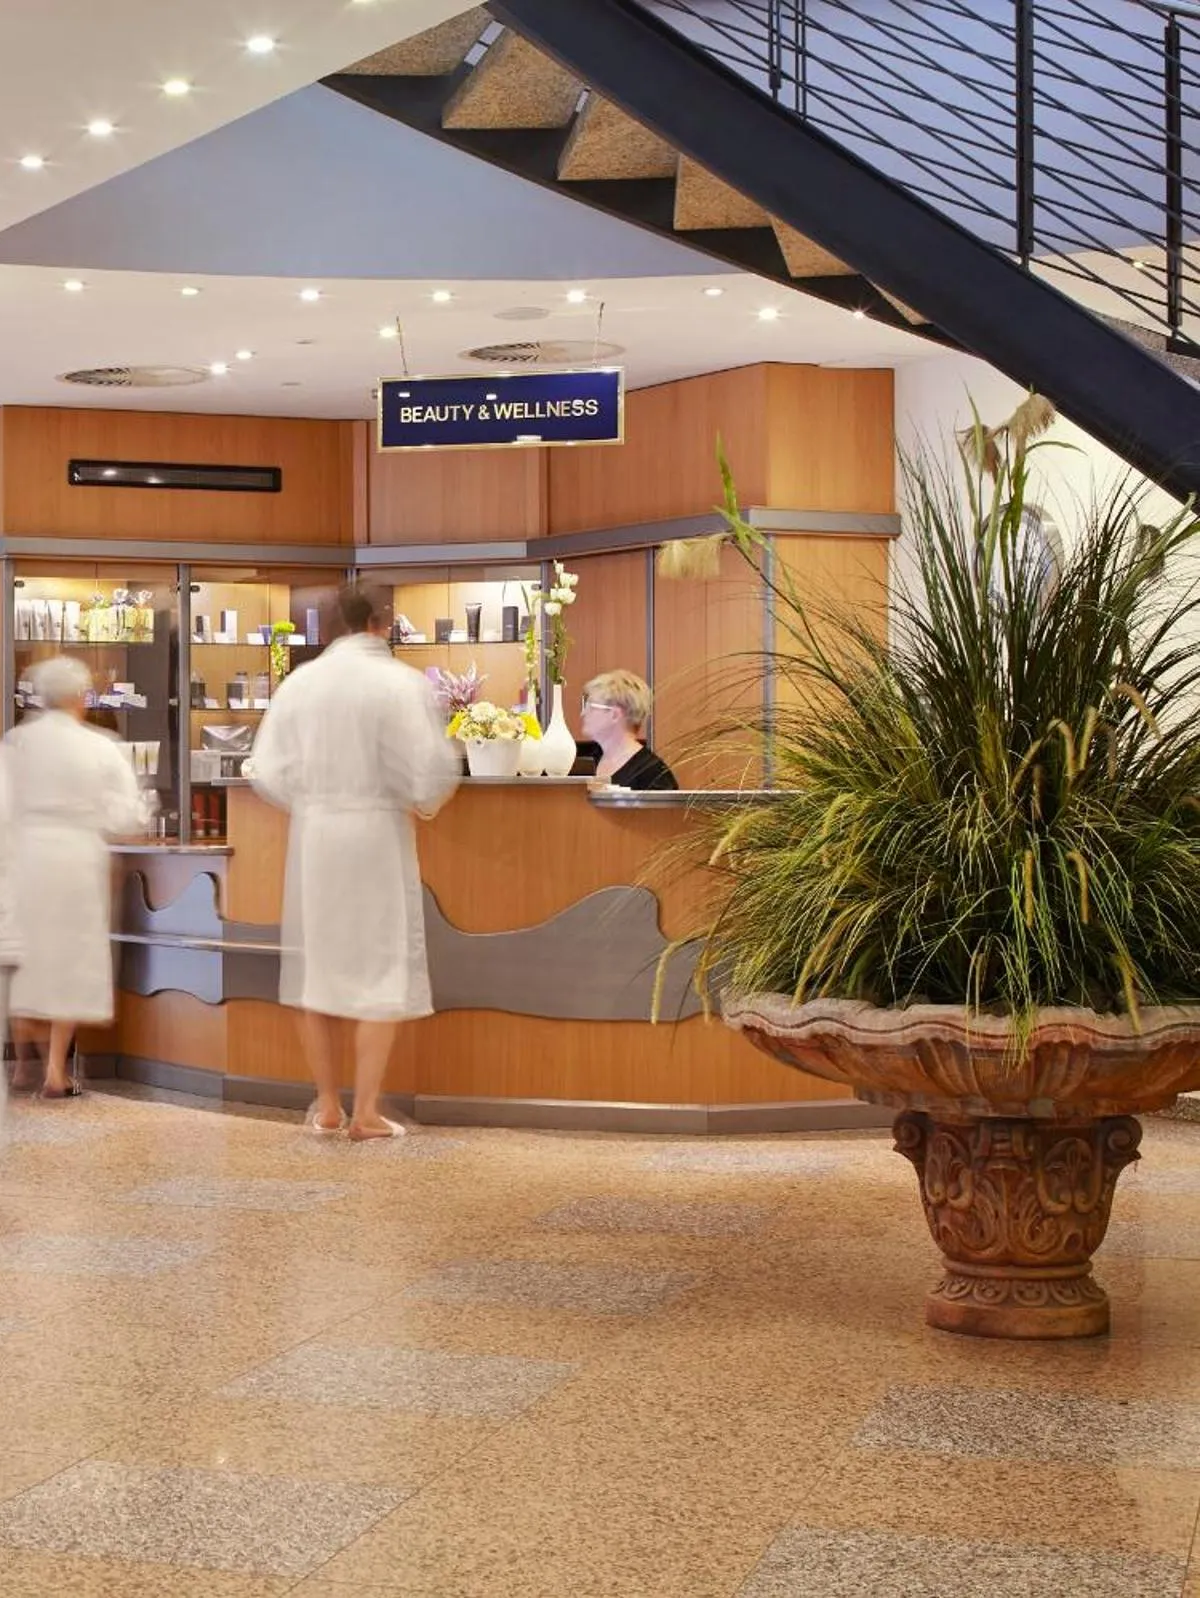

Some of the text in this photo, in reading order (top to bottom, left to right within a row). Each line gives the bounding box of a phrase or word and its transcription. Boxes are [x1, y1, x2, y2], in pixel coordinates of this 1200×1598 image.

[400, 399, 599, 423] BEAUTY & WELLNESS
